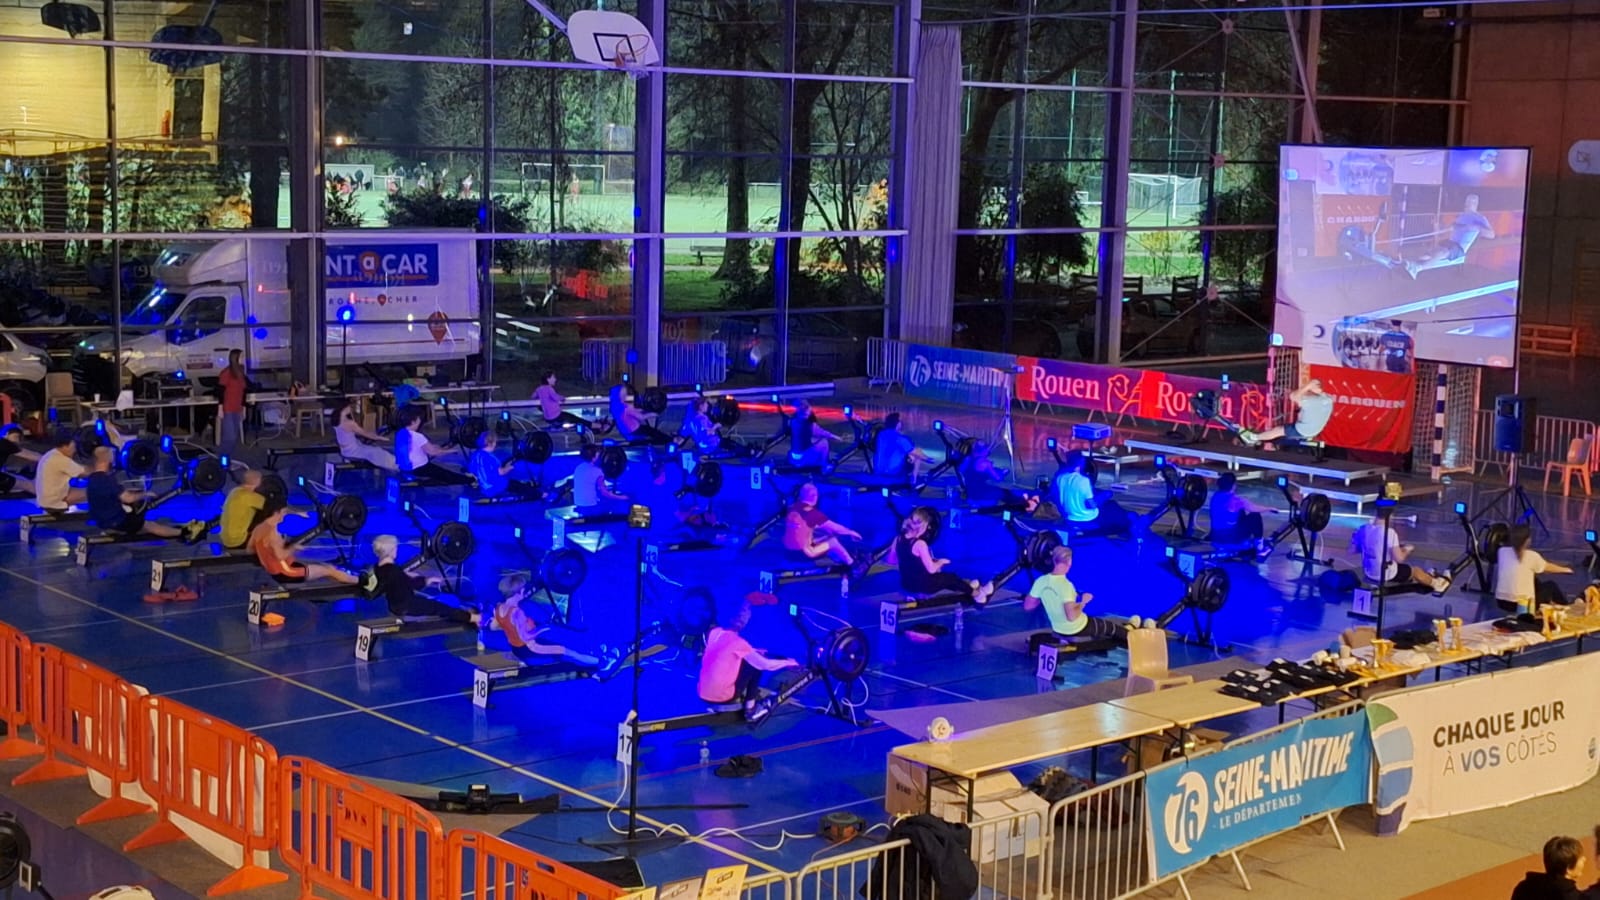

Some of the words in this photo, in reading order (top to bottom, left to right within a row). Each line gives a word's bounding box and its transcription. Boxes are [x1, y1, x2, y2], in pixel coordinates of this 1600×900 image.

[326, 254, 356, 276] NT
[381, 252, 428, 275] CAR
[1030, 365, 1101, 400] Rouen
[1155, 381, 1234, 418] Ron
[752, 472, 760, 485] 6
[645, 550, 658, 567] 13
[152, 570, 161, 583] 21
[249, 599, 259, 617] 20
[881, 609, 895, 627] 15
[358, 634, 369, 653] 19
[1040, 653, 1055, 673] 16
[475, 679, 486, 698] 18
[1433, 711, 1516, 748] CHAQUE
[1521, 700, 1565, 730] JOUR
[619, 733, 633, 755] 17
[1443, 750, 1455, 777] À
[1460, 746, 1501, 773] VOS
[1506, 730, 1557, 764] CÔTÉS
[1164, 771, 1209, 855] 76
[1219, 815, 1232, 830] LE
